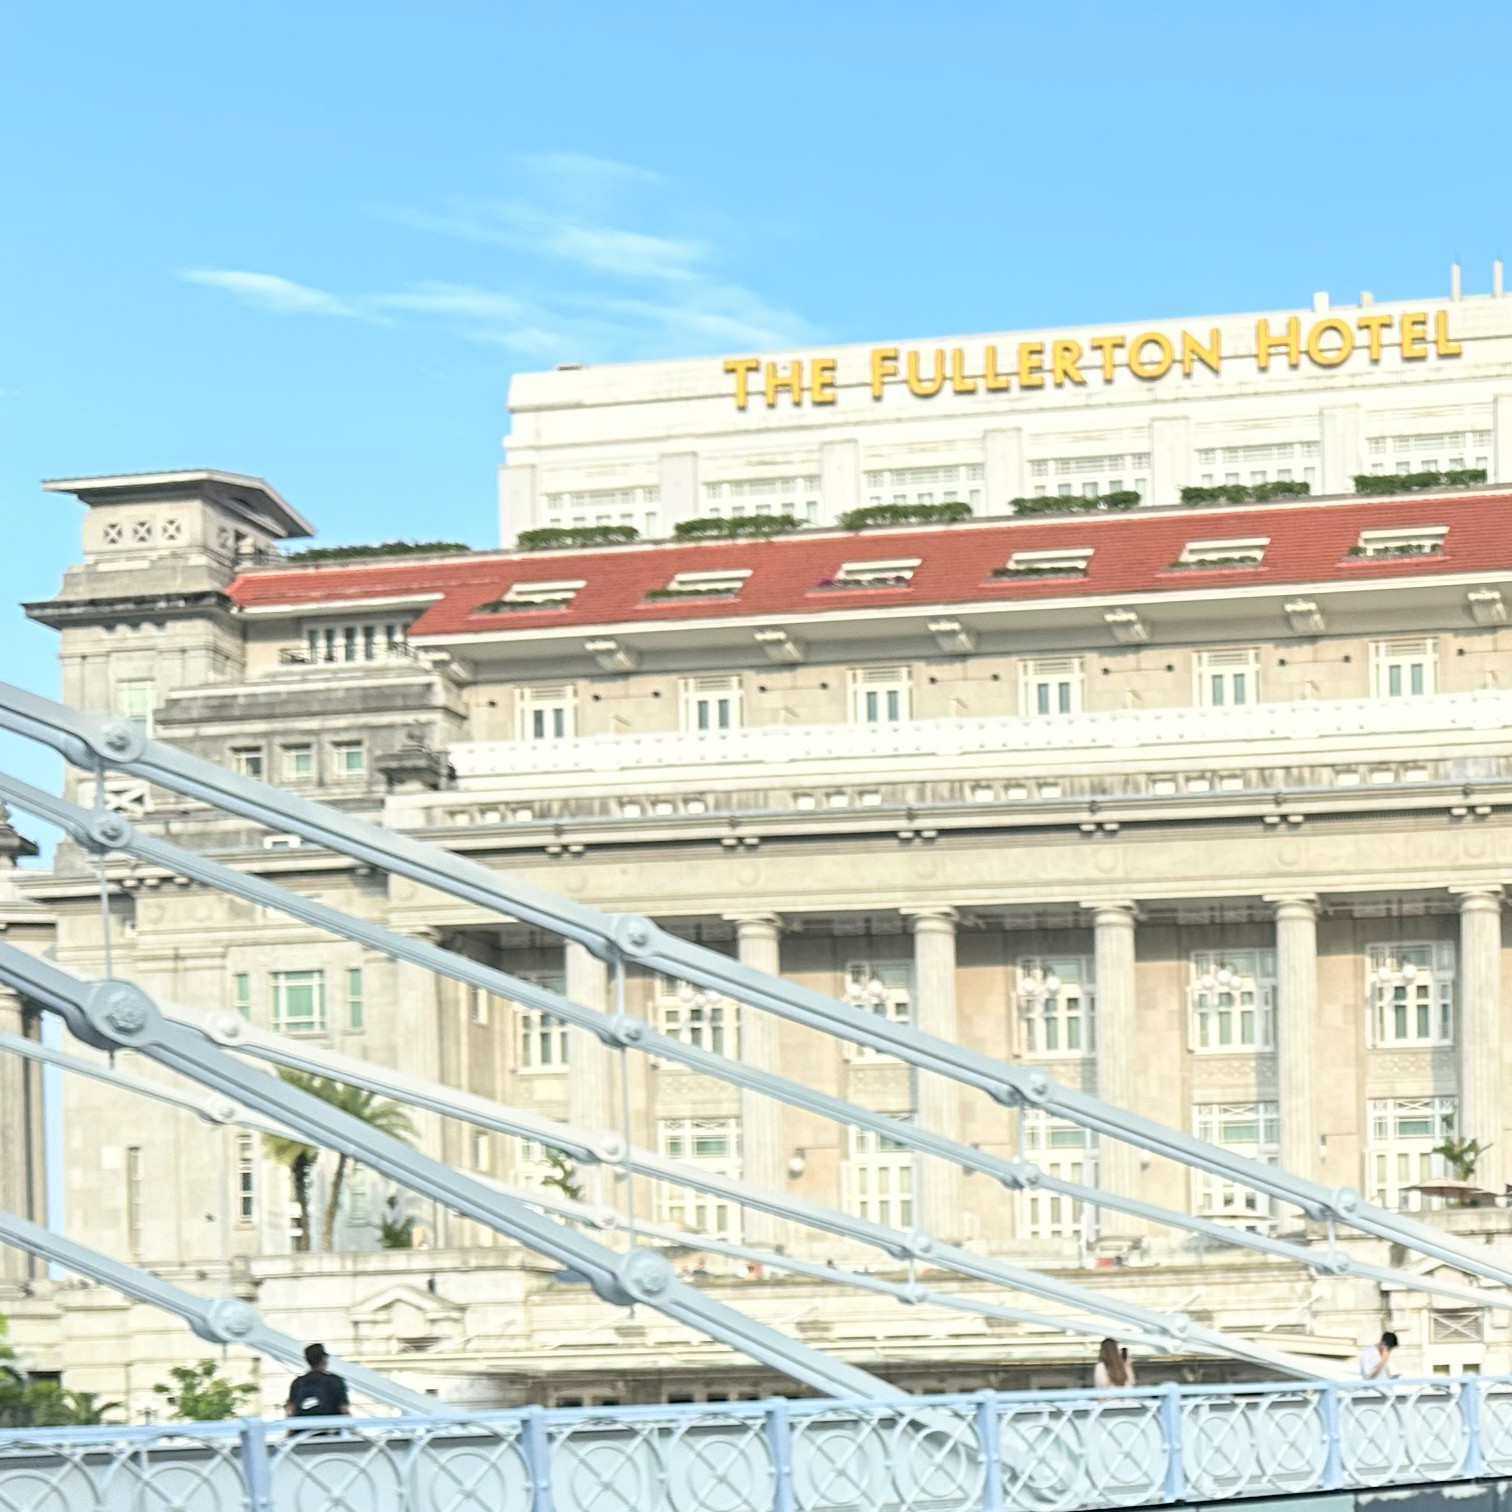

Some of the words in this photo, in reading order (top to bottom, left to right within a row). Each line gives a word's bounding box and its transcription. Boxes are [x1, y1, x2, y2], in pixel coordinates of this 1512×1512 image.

[724, 357, 836, 409] THE
[870, 328, 1221, 399] FULLERTON
[1254, 310, 1463, 368] HOTEL
